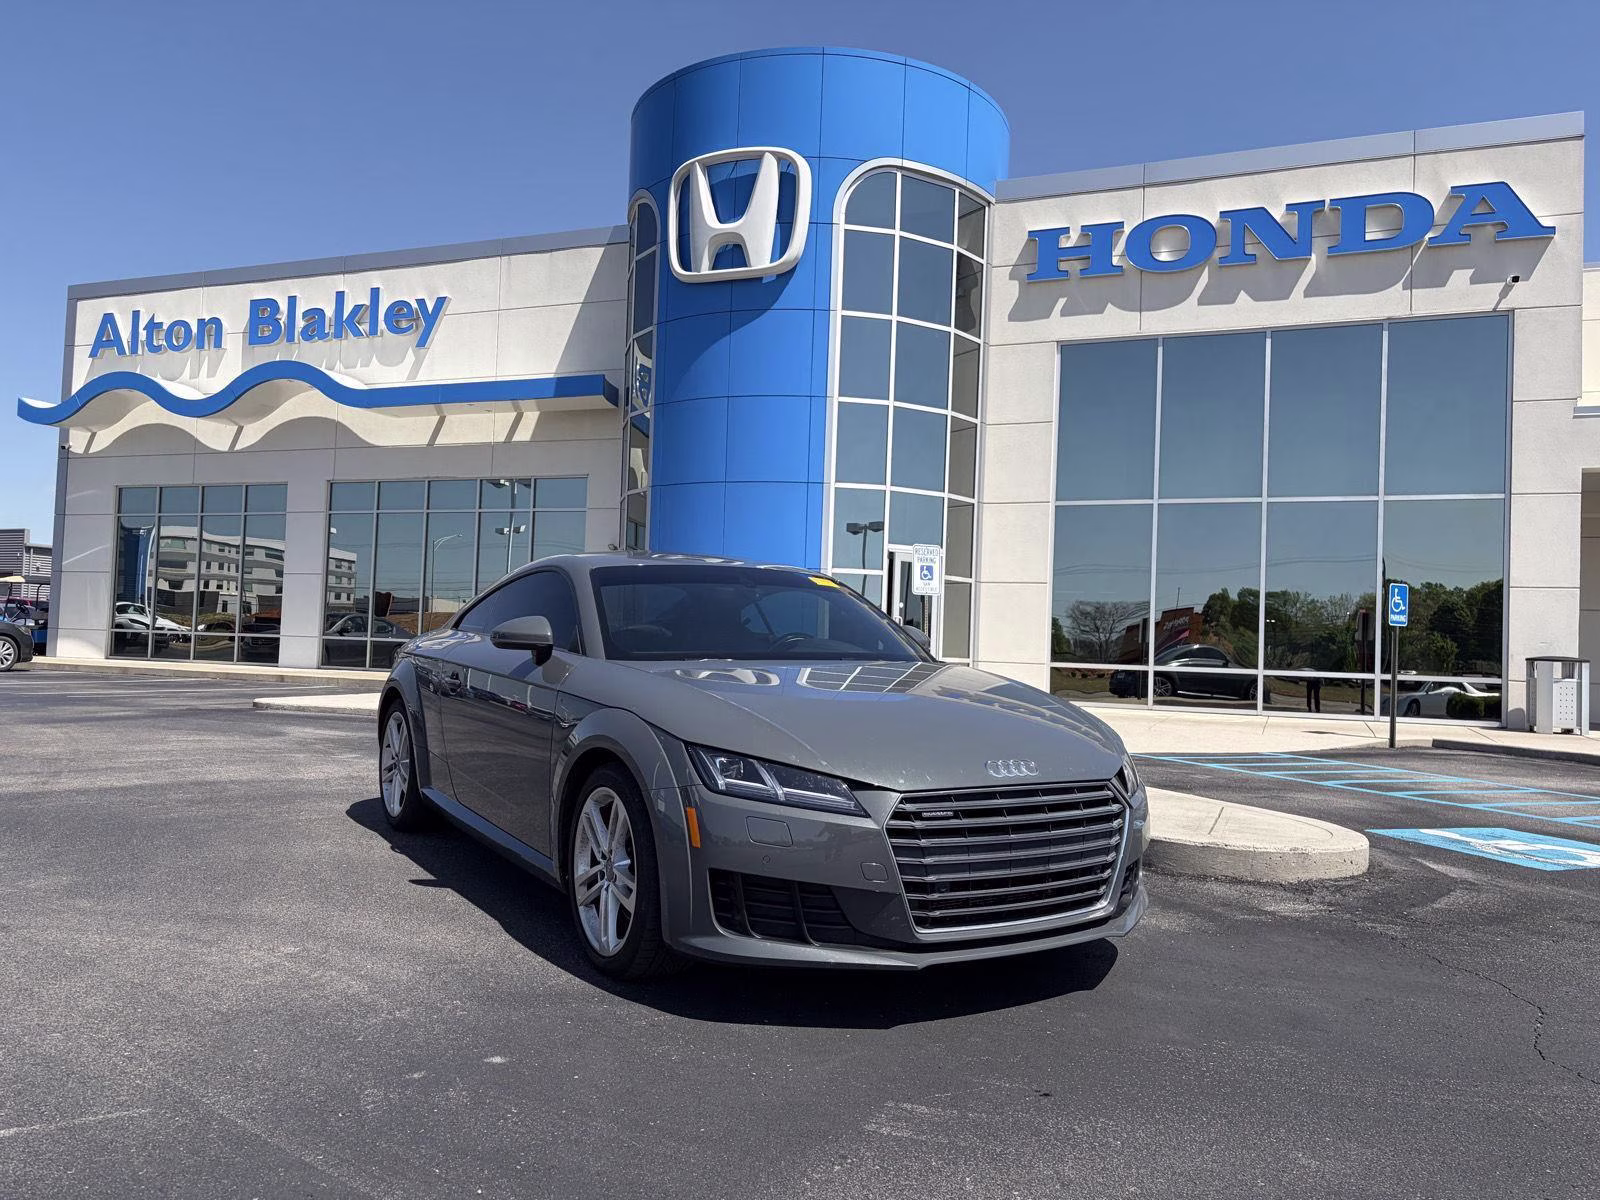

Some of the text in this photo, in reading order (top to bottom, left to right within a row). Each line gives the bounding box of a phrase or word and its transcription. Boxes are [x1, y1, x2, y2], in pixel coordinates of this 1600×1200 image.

[1027, 181, 1556, 283] HONDA
[89, 287, 451, 359] Alton Blakley
[915, 547, 938, 557] RESERVED
[917, 556, 937, 564] PARKING
